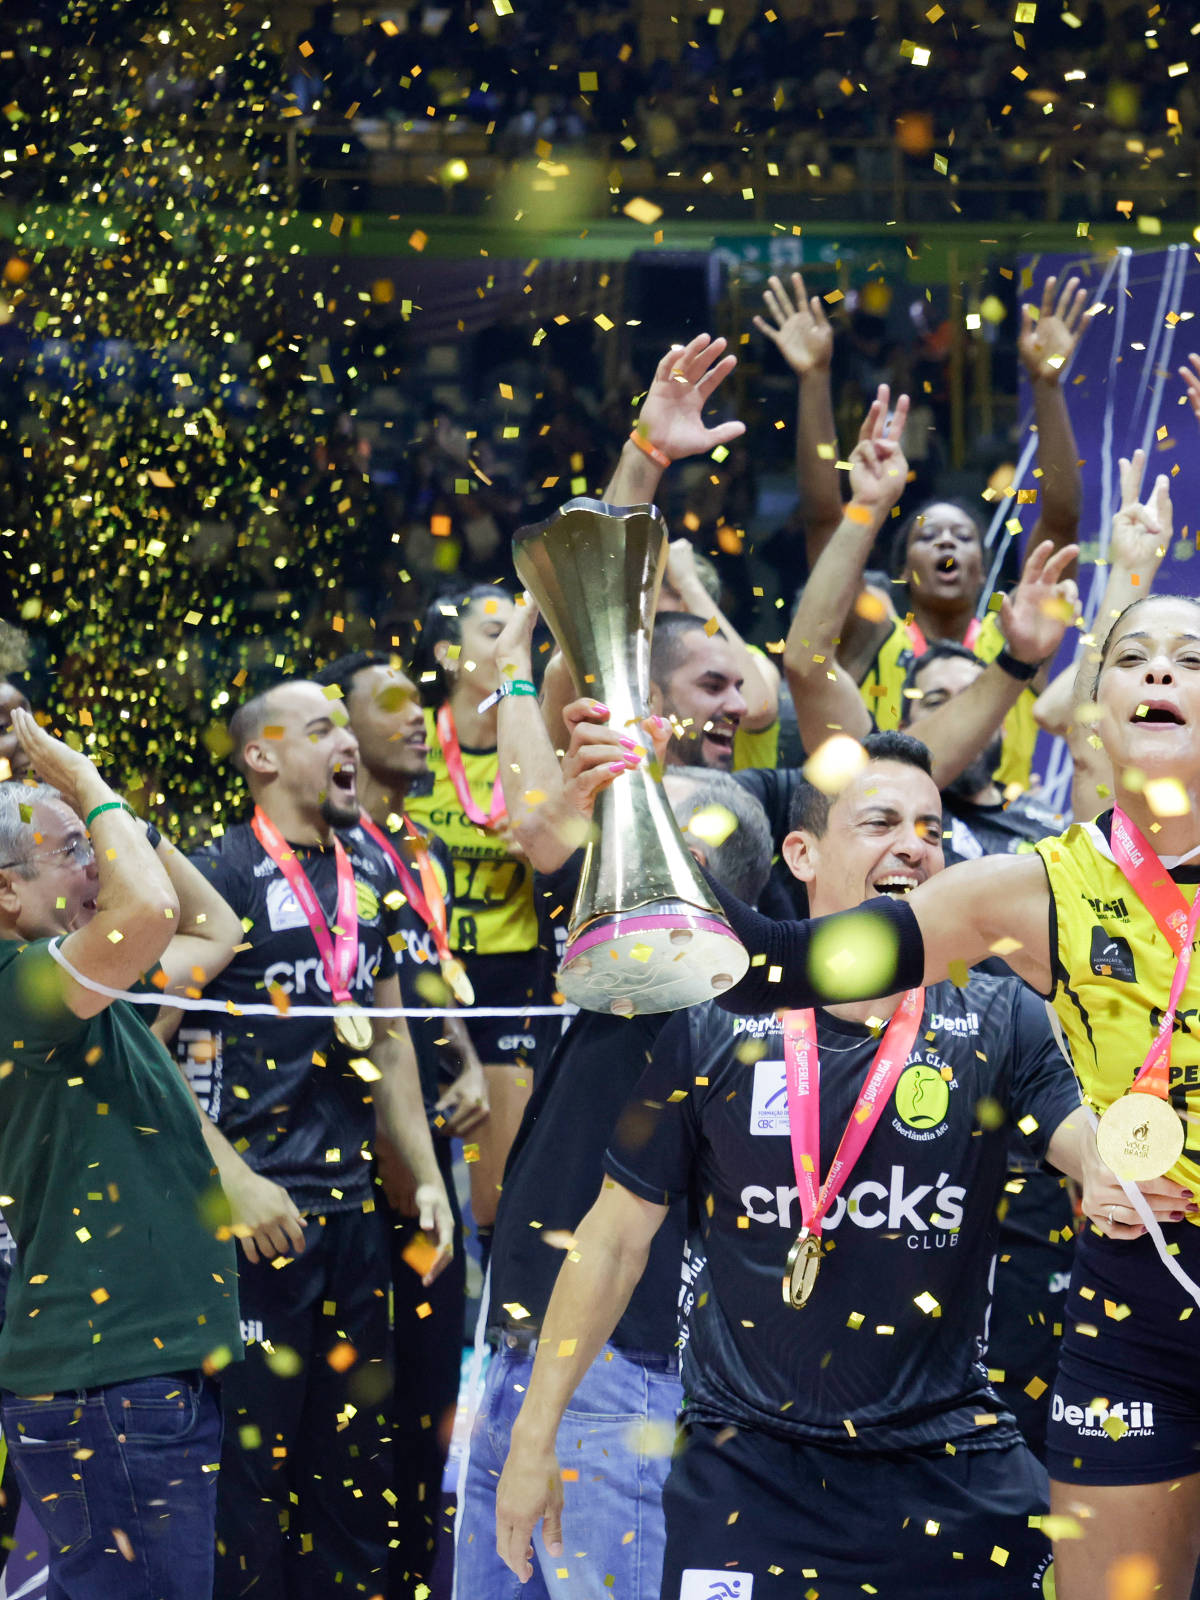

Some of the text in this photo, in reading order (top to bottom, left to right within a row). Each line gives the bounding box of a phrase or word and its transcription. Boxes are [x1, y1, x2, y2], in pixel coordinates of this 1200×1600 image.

[1114, 824, 1145, 869] SUPERLIGA
[796, 1050, 810, 1097] SUPERLIGA
[864, 1058, 893, 1103] SUPERLIGA
[926, 1053, 959, 1091] CLUE
[757, 1119, 774, 1129] CBC
[891, 1117, 950, 1142] Uberlândia MG
[906, 1232, 959, 1250] CLUB
[1052, 1394, 1154, 1429] Dentil
[1078, 1427, 1155, 1439] Usou, orriu.
